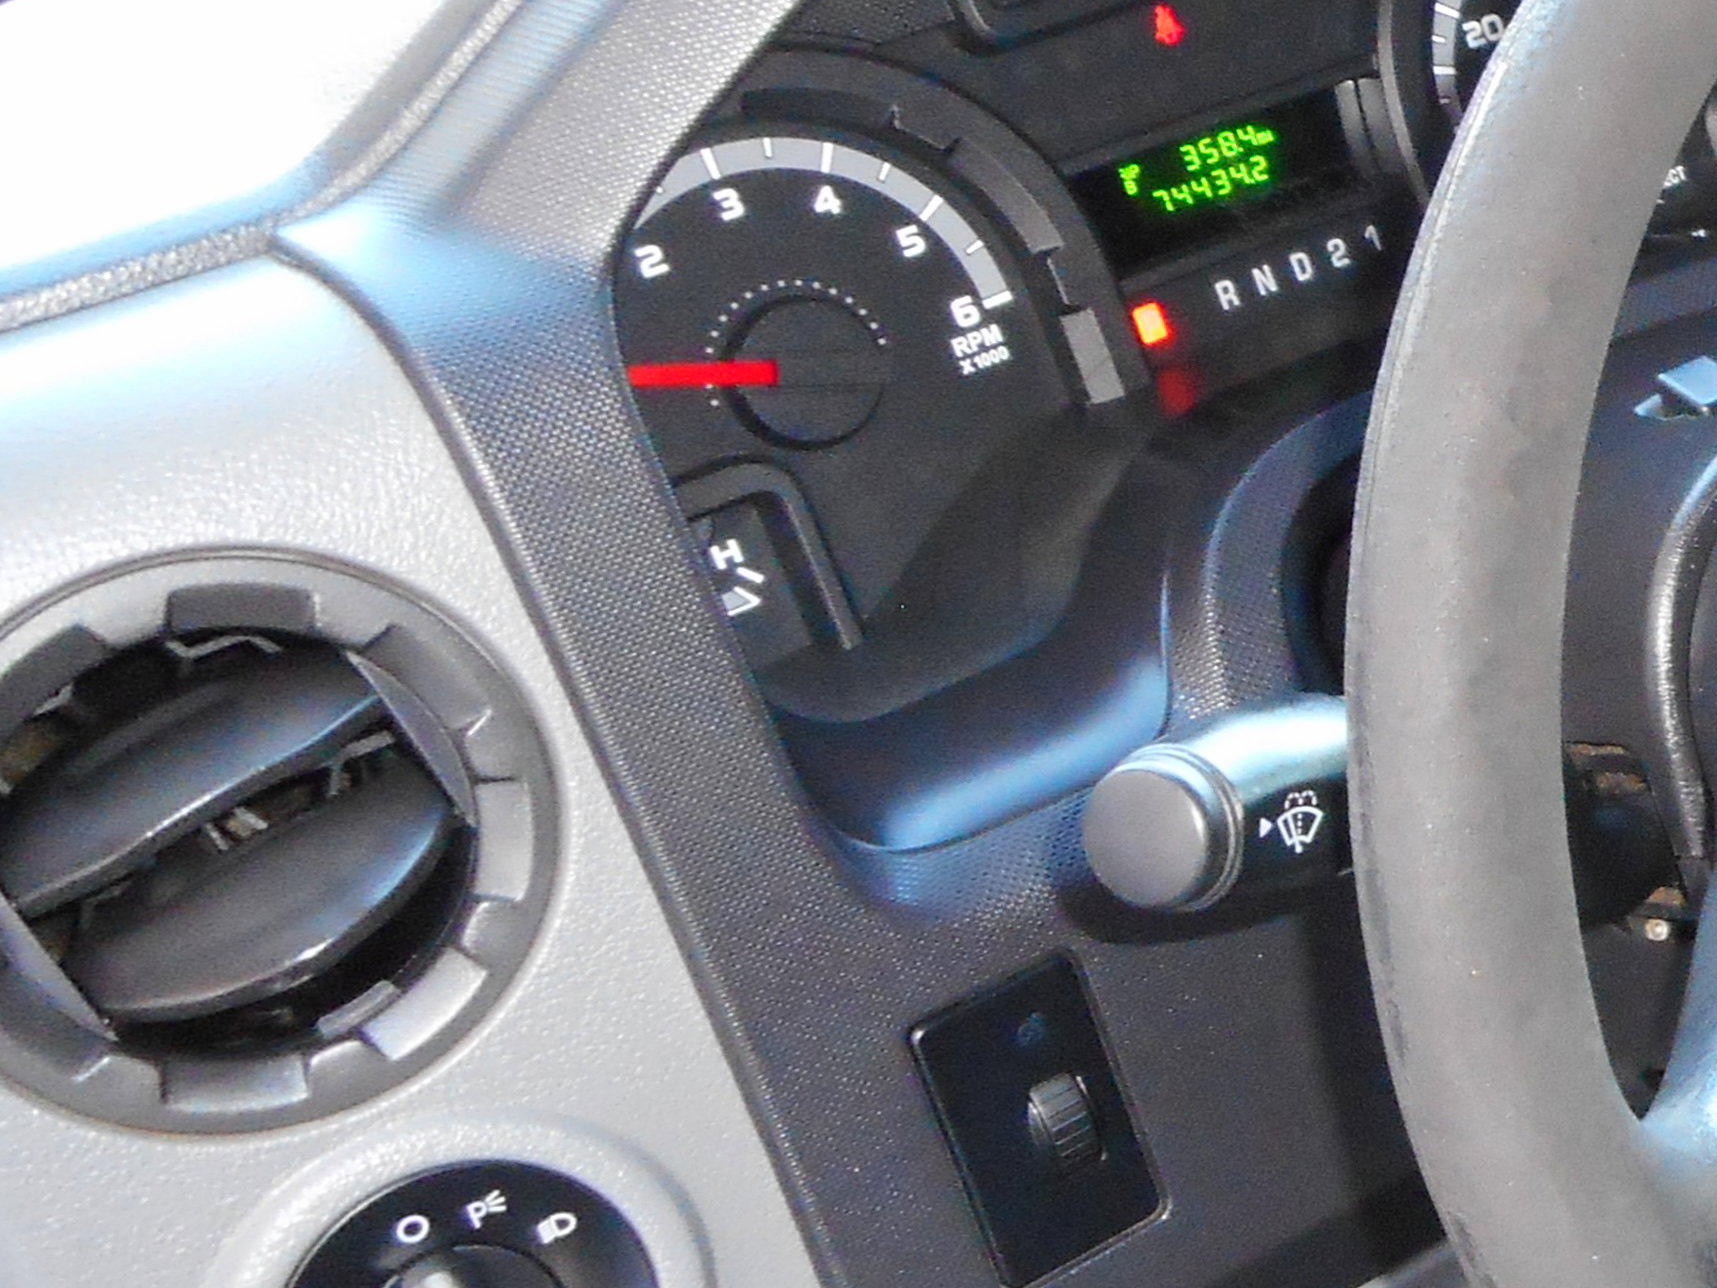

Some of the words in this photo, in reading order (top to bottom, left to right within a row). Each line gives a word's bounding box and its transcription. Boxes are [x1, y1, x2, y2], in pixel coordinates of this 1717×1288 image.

[1462, 14, 1504, 49] 20
[713, 188, 745, 221] 3
[813, 185, 842, 214] 4
[896, 225, 927, 258] 5
[634, 244, 671, 279] 2
[1214, 279, 1241, 311] R
[1252, 264, 1278, 296] N
[1289, 252, 1316, 282] D
[1326, 238, 1351, 268] 2
[1364, 224, 1382, 251] 1
[949, 294, 982, 329] 6
[949, 324, 1004, 358] RPM
[710, 538, 744, 570] H
